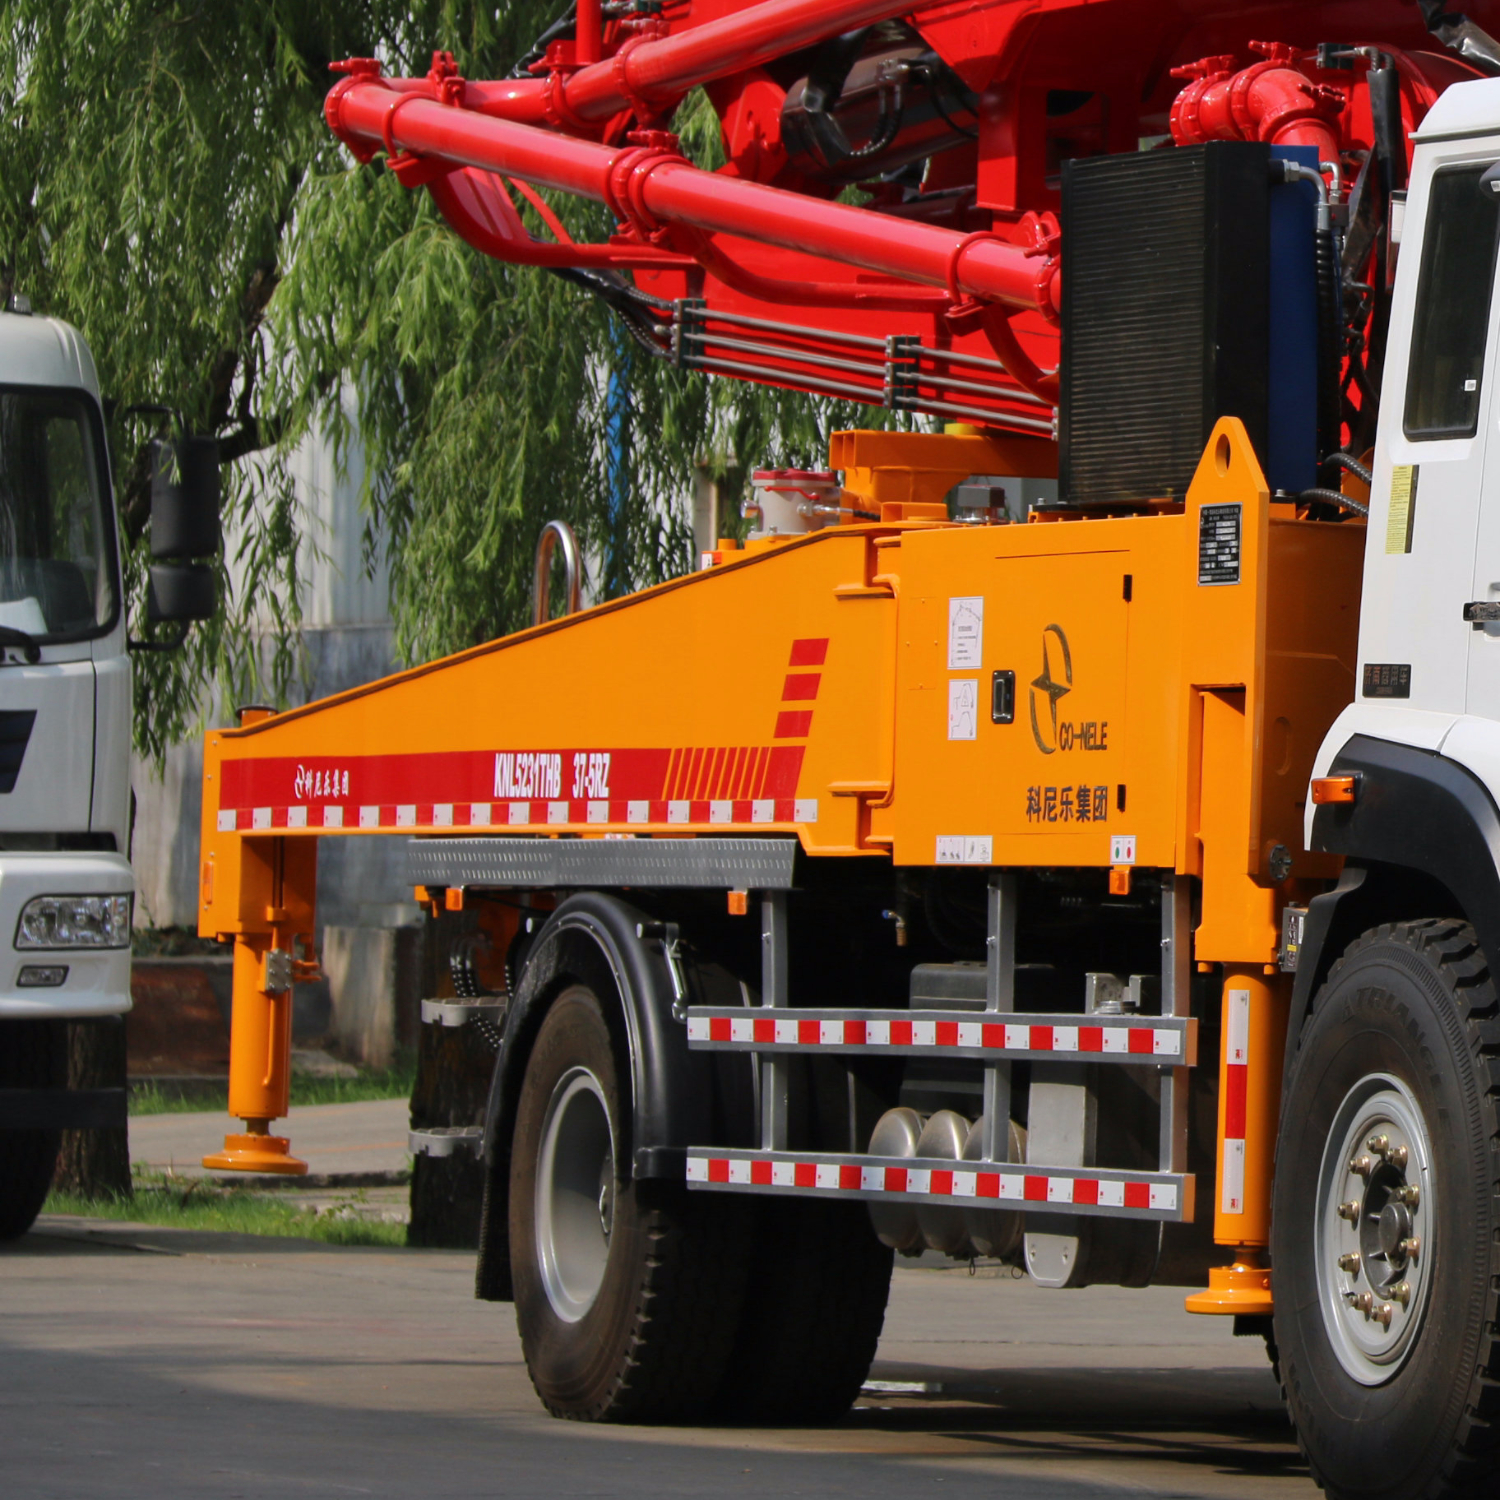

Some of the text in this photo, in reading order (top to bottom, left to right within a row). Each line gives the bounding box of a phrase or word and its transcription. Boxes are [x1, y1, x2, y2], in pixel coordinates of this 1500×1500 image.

[1059, 721, 1108, 751] CO-NELE
[493, 752, 611, 798] KNL5231THB 37-5RZ
[1026, 785, 1108, 823] 科尼乐集团
